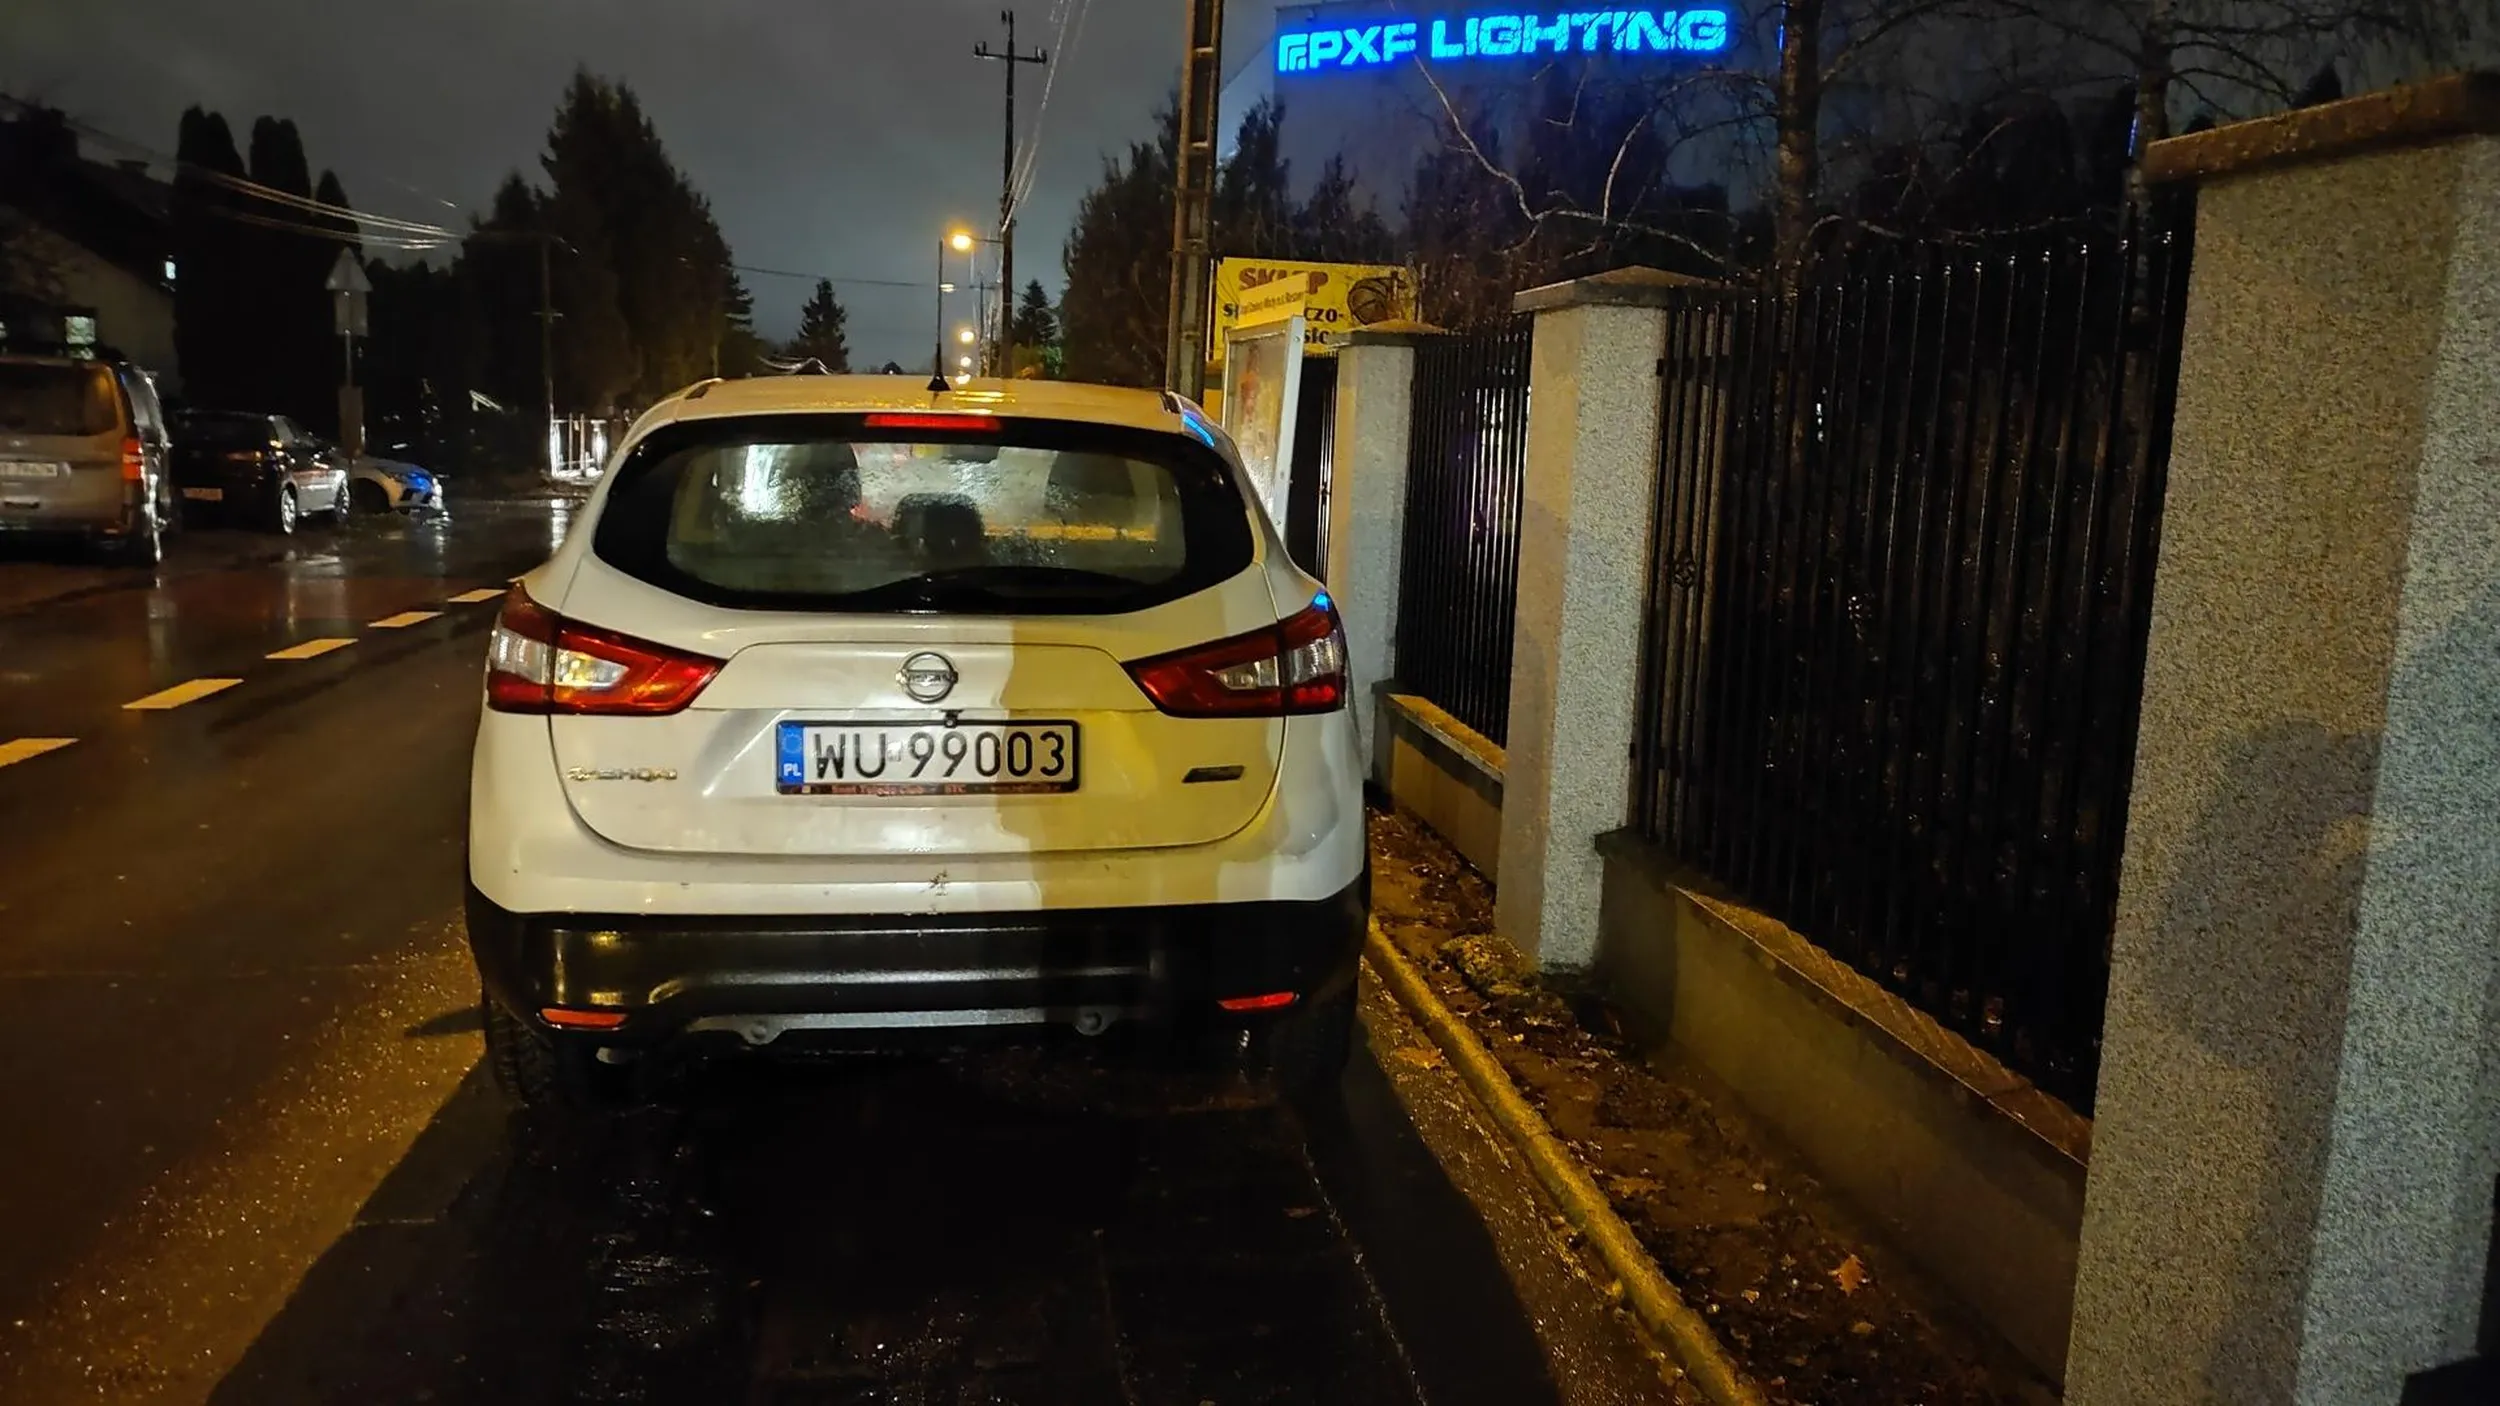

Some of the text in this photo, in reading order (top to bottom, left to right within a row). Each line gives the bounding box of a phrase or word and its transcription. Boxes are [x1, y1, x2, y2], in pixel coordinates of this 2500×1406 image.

[1431, 9, 1727, 59] LIGHTING
[1239, 267, 1329, 295] SKP
[783, 763, 801, 777] PL
[814, 731, 1065, 779] WU 99003
